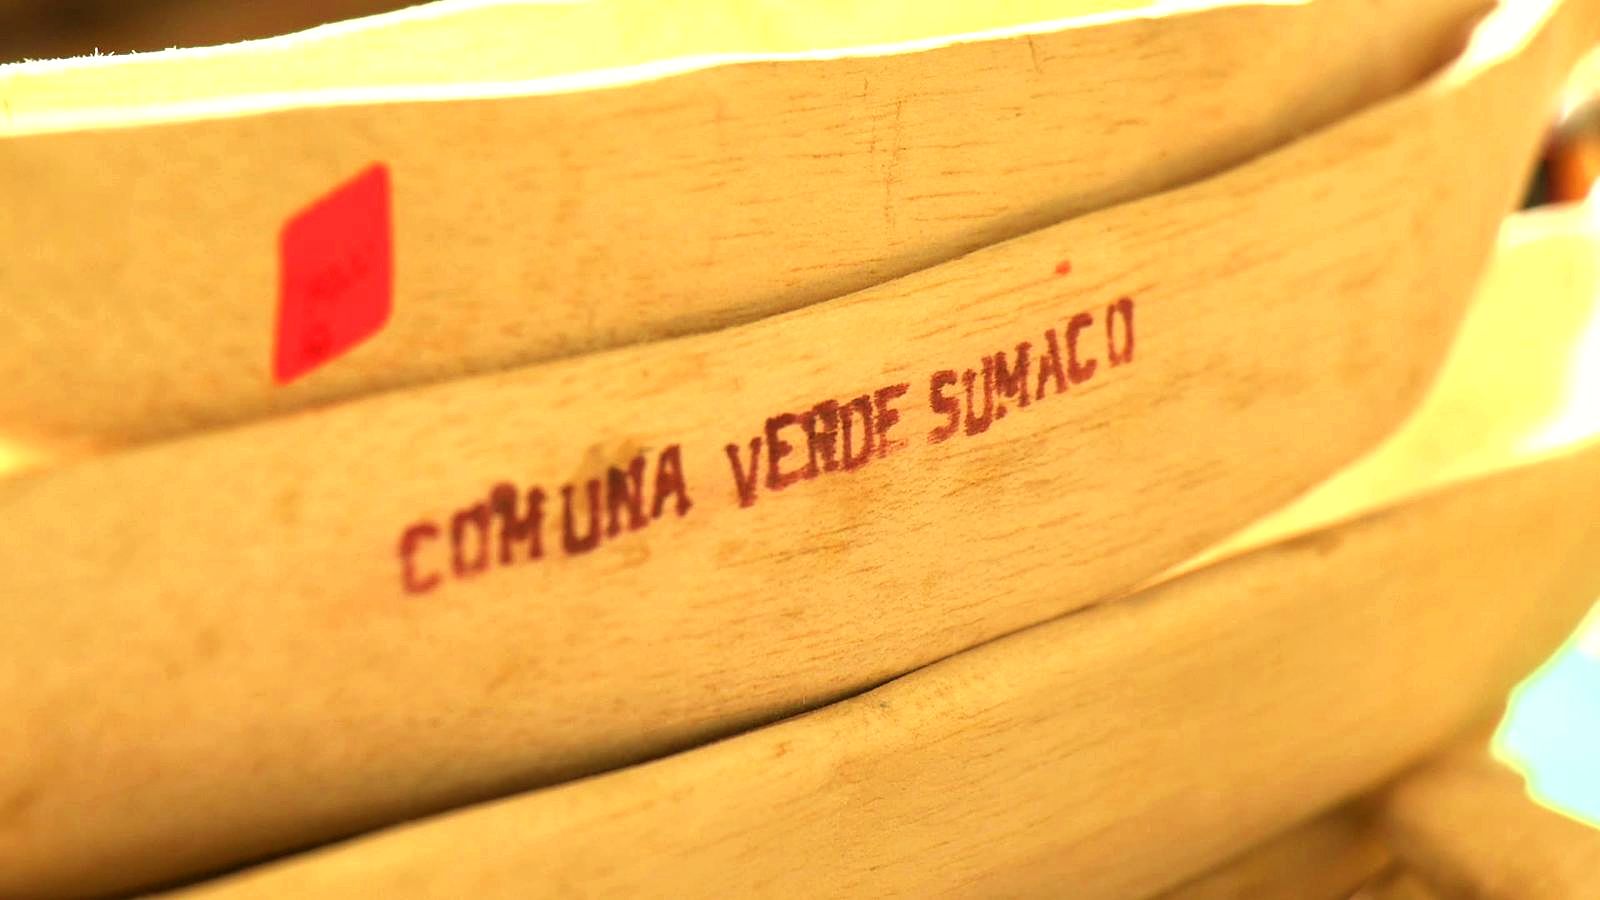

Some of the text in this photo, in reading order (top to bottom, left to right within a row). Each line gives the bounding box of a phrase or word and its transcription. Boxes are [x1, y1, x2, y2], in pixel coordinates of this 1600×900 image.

[398, 296, 1135, 596] COMUNA VERDE SUMACO
